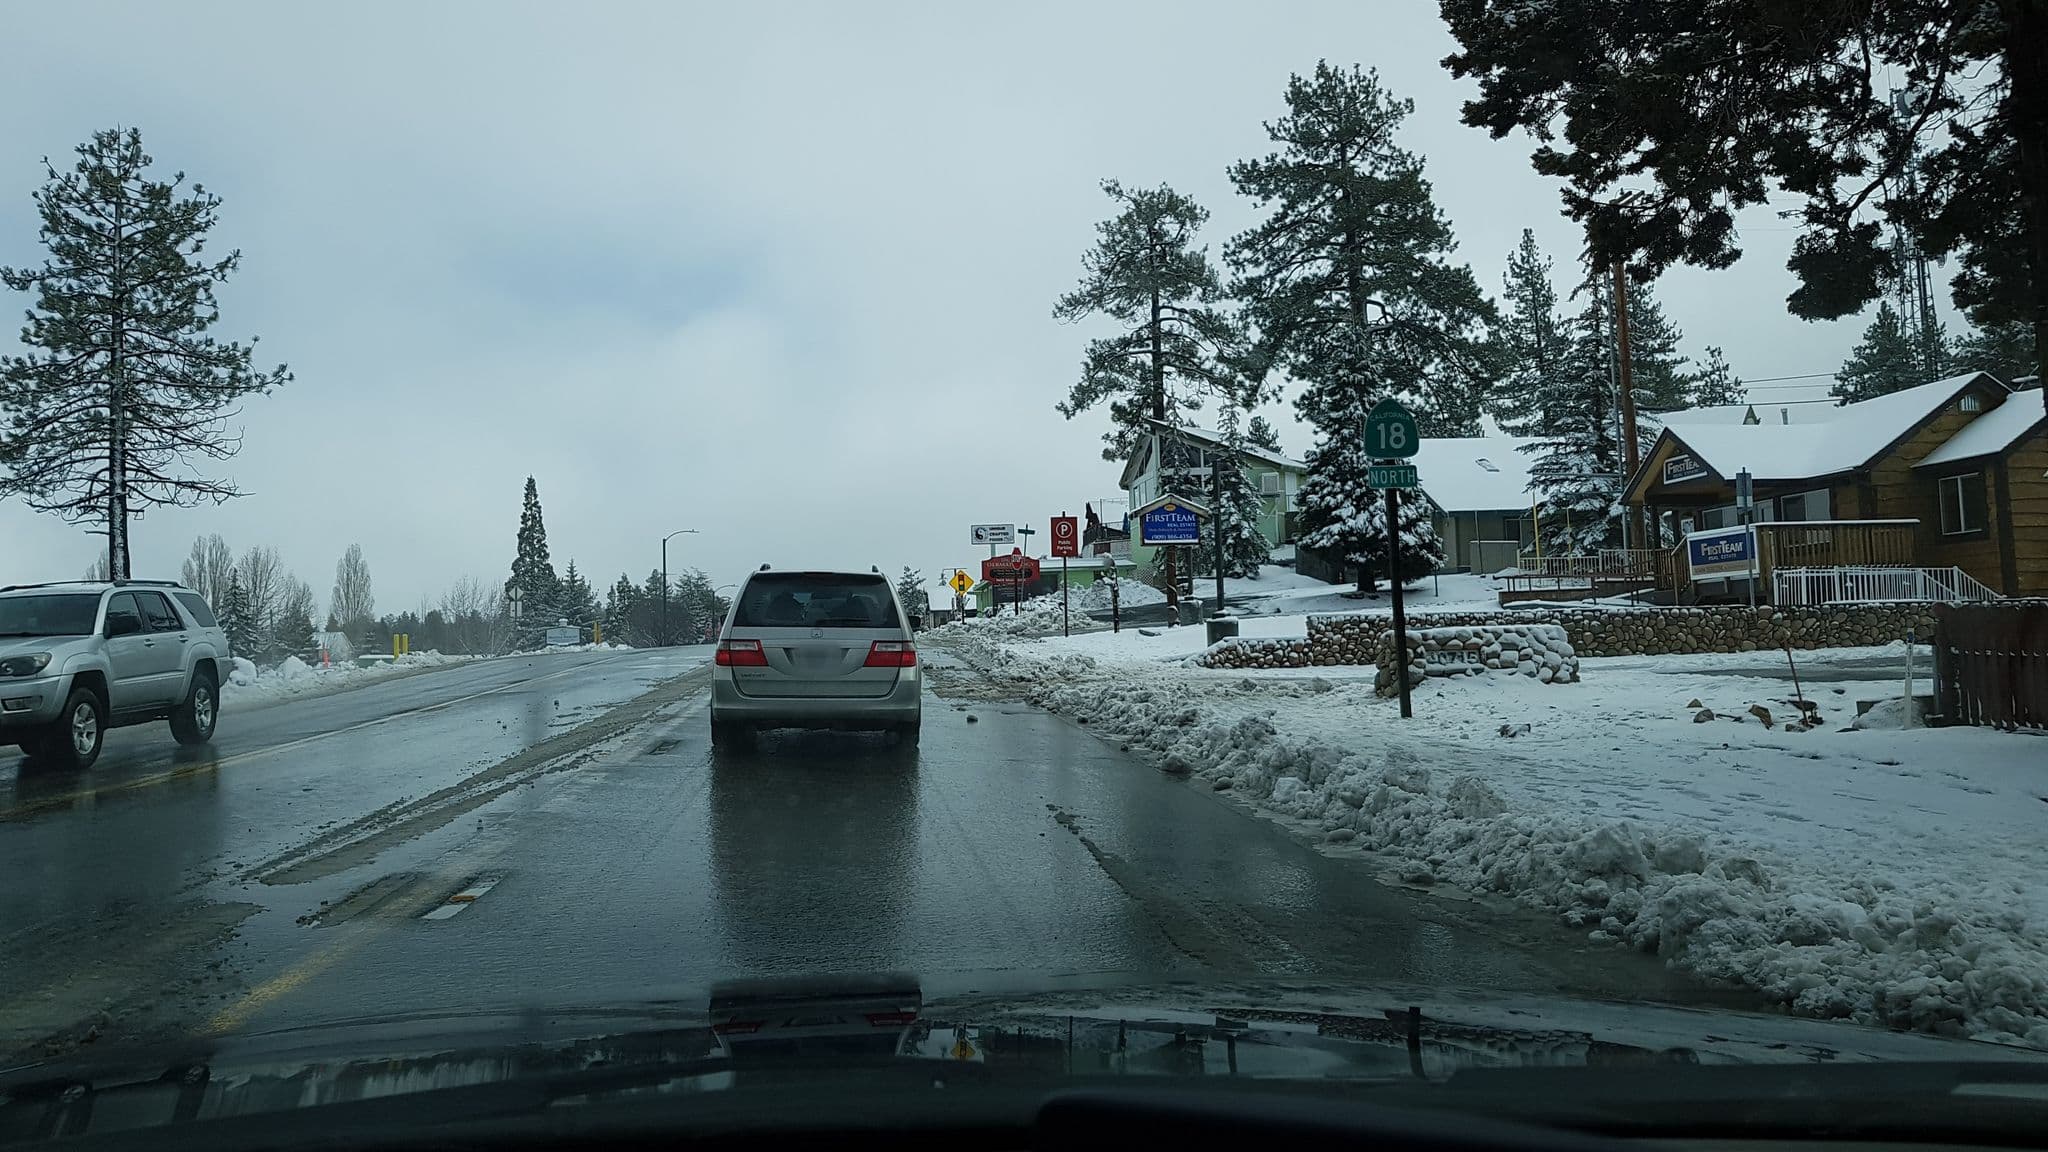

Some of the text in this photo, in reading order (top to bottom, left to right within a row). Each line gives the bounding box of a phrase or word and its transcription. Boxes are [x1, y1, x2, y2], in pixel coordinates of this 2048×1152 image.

[1377, 422, 1406, 450] 18
[1370, 469, 1416, 484] NORTH
[1060, 524, 1068, 536] P
